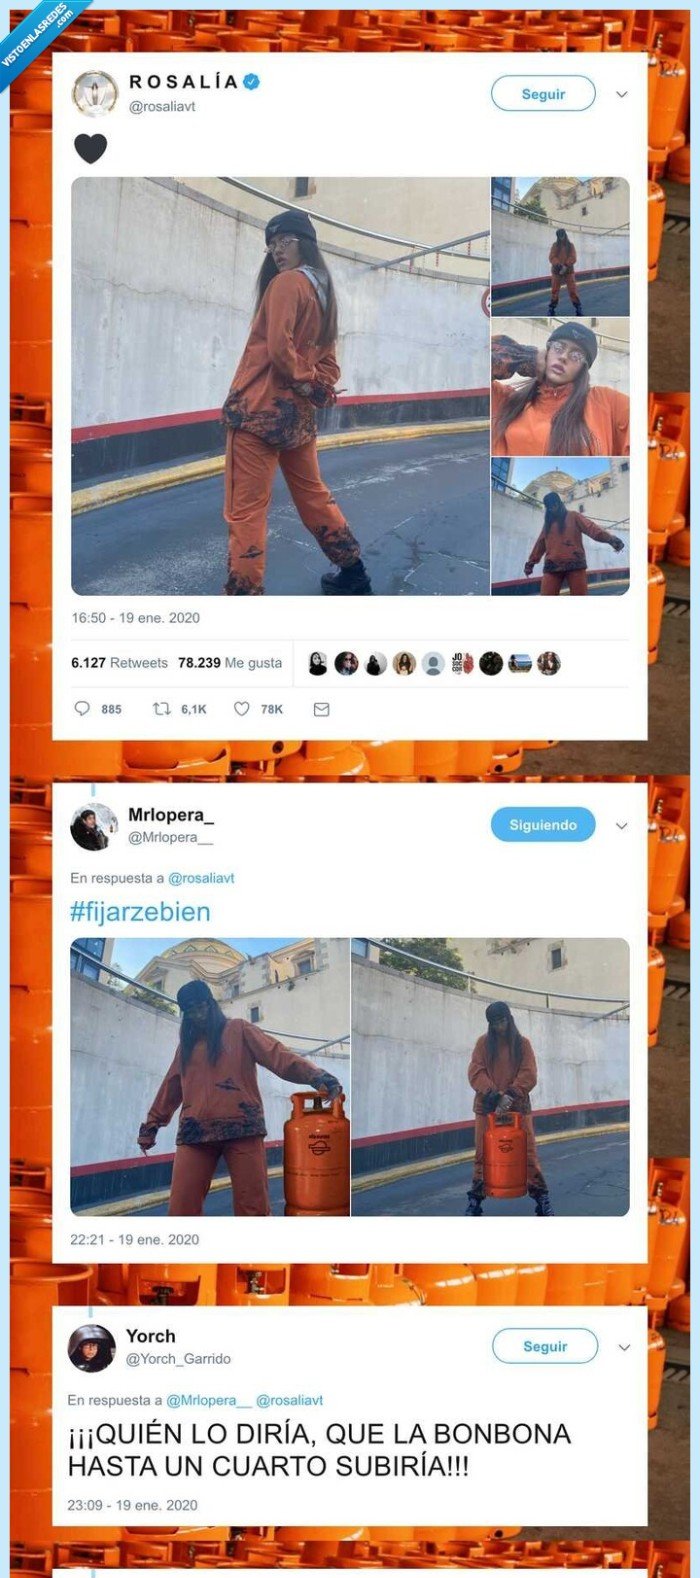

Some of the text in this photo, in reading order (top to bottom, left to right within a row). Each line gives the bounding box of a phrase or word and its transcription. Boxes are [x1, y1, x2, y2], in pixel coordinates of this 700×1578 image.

[522, 88, 566, 102] Seguir
[129, 101, 195, 114] @rosaliavt
[73, 612, 200, 623] 16:50 19 ene. 2020
[72, 657, 282, 671] 6.127 Retweets 78.239 Me gusta
[102, 705, 121, 714] 885
[182, 705, 206, 715] 6,1K
[262, 705, 282, 714] 78K
[129, 807, 214, 825] Mrlopera_
[511, 820, 577, 833] Siguiendo
[70, 901, 210, 927] #fijarzebien
[126, 1329, 175, 1343] Yorch
[524, 1341, 567, 1355] Seguir
[126, 1353, 231, 1367] @Yorch_Garrido
[68, 1395, 84, 1405] En
[89, 1395, 150, 1408] respuesta
[155, 1397, 162, 1405] a
[257, 1394, 323, 1408] @rosaliavt
[70, 1419, 571, 1449] ¡¡¡QUIÉN LO DIRÍA, QUE LA BONBONA
[69, 1451, 468, 1477] HASTA UN CUARTO SUBIRÍA!!!
